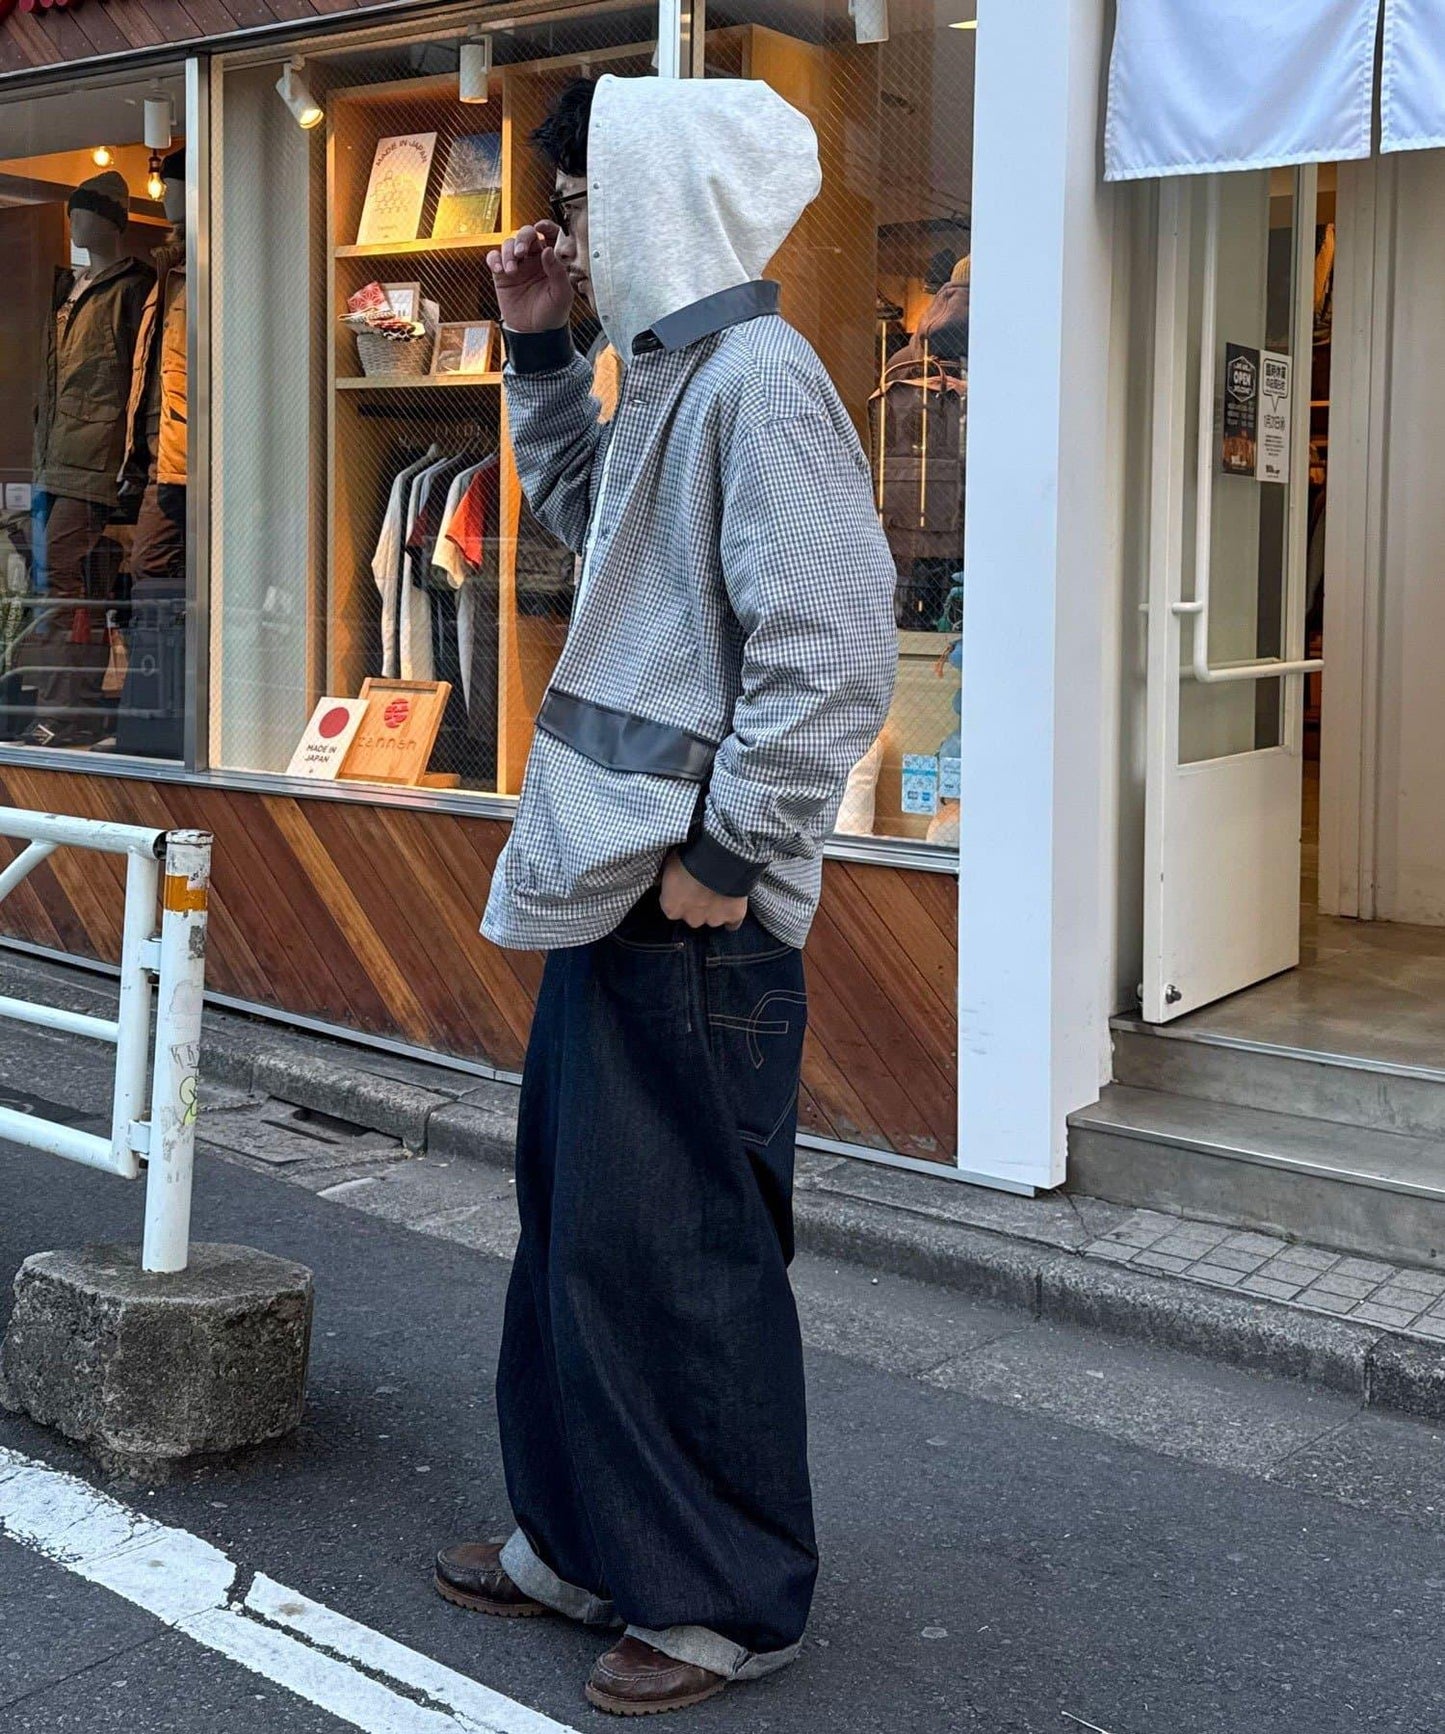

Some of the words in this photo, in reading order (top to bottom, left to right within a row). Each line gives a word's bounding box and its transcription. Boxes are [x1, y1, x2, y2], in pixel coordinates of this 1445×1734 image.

[376, 142, 398, 166] MADE
[399, 139, 408, 147] IN
[409, 140, 428, 164] JAPAN
[1234, 370, 1252, 386] OPEN
[306, 745, 328, 753] MADE
[329, 746, 338, 754] IN
[304, 755, 330, 763] JAPAN
